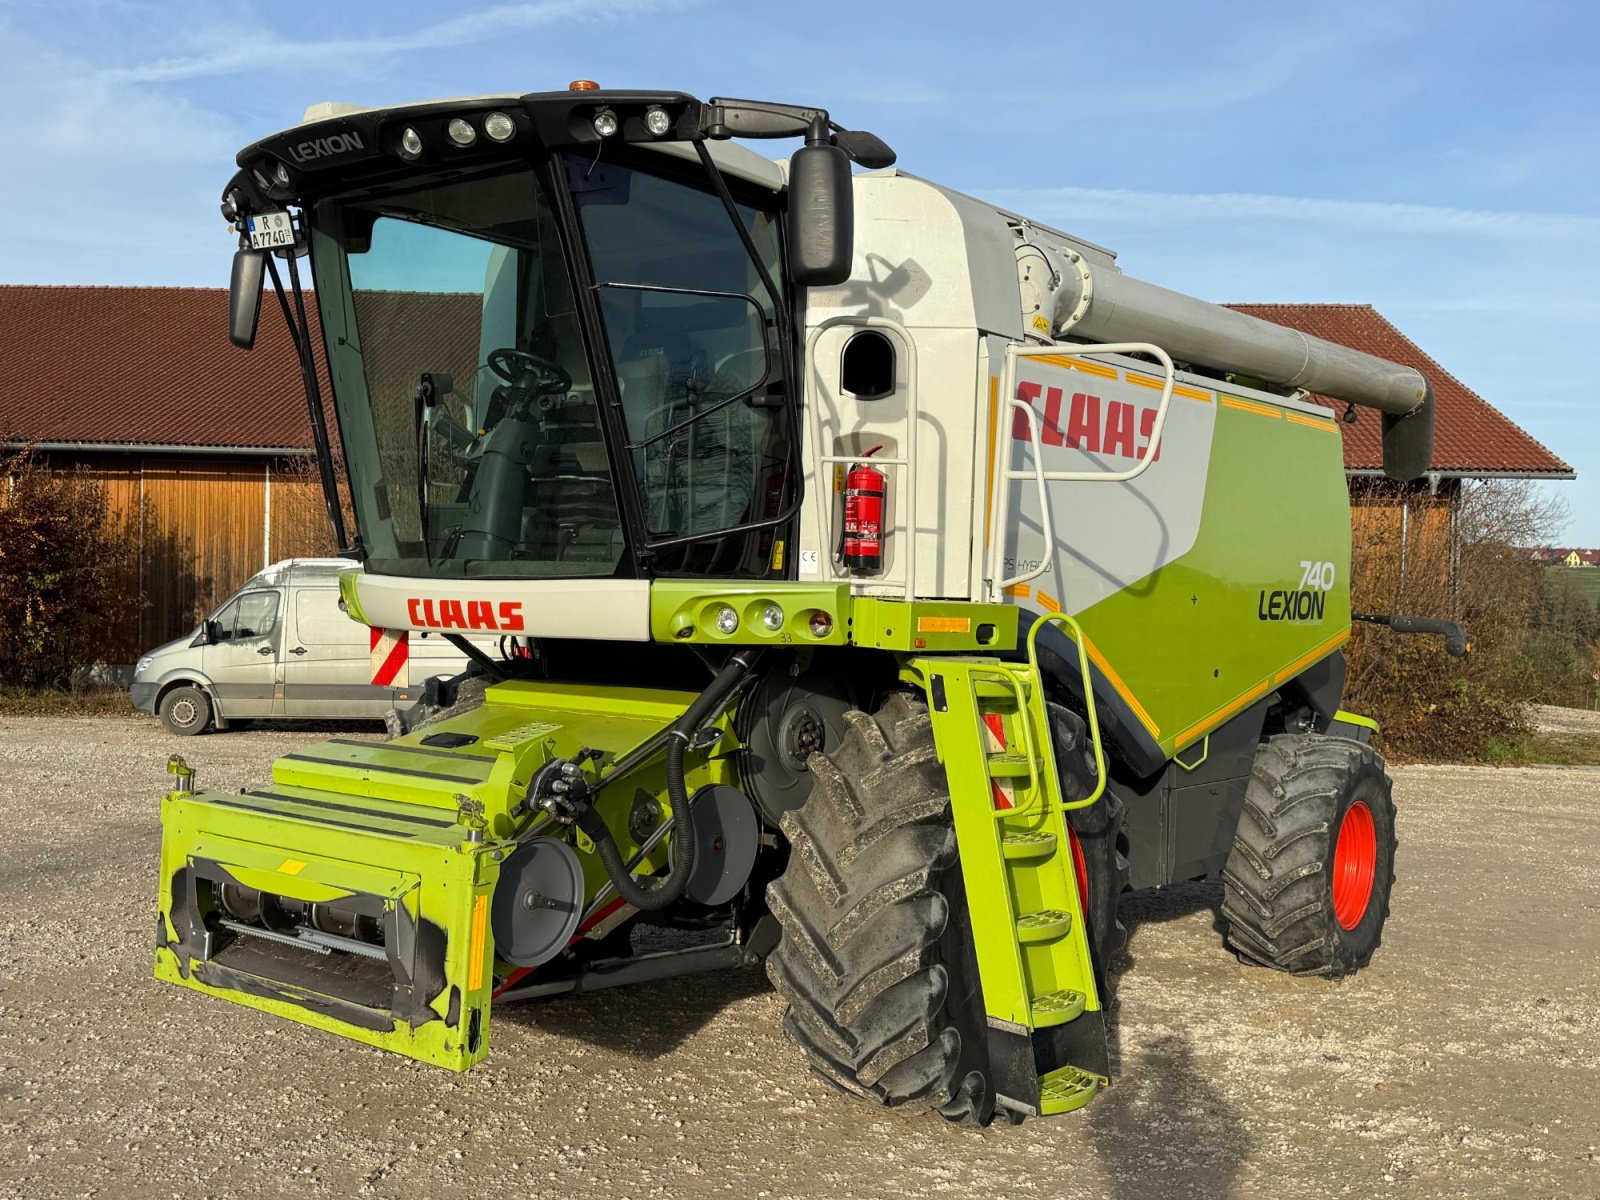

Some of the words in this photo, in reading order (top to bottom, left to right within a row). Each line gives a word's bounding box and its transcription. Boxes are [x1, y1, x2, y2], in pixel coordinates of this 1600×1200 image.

[288, 131, 365, 163] LEXION
[262, 216, 270, 230] R
[1012, 380, 1162, 462] CLAAS
[1298, 560, 1335, 591] 740
[407, 598, 525, 631] CLAAS
[1258, 590, 1325, 620] LEXION
[781, 632, 792, 643] 33
